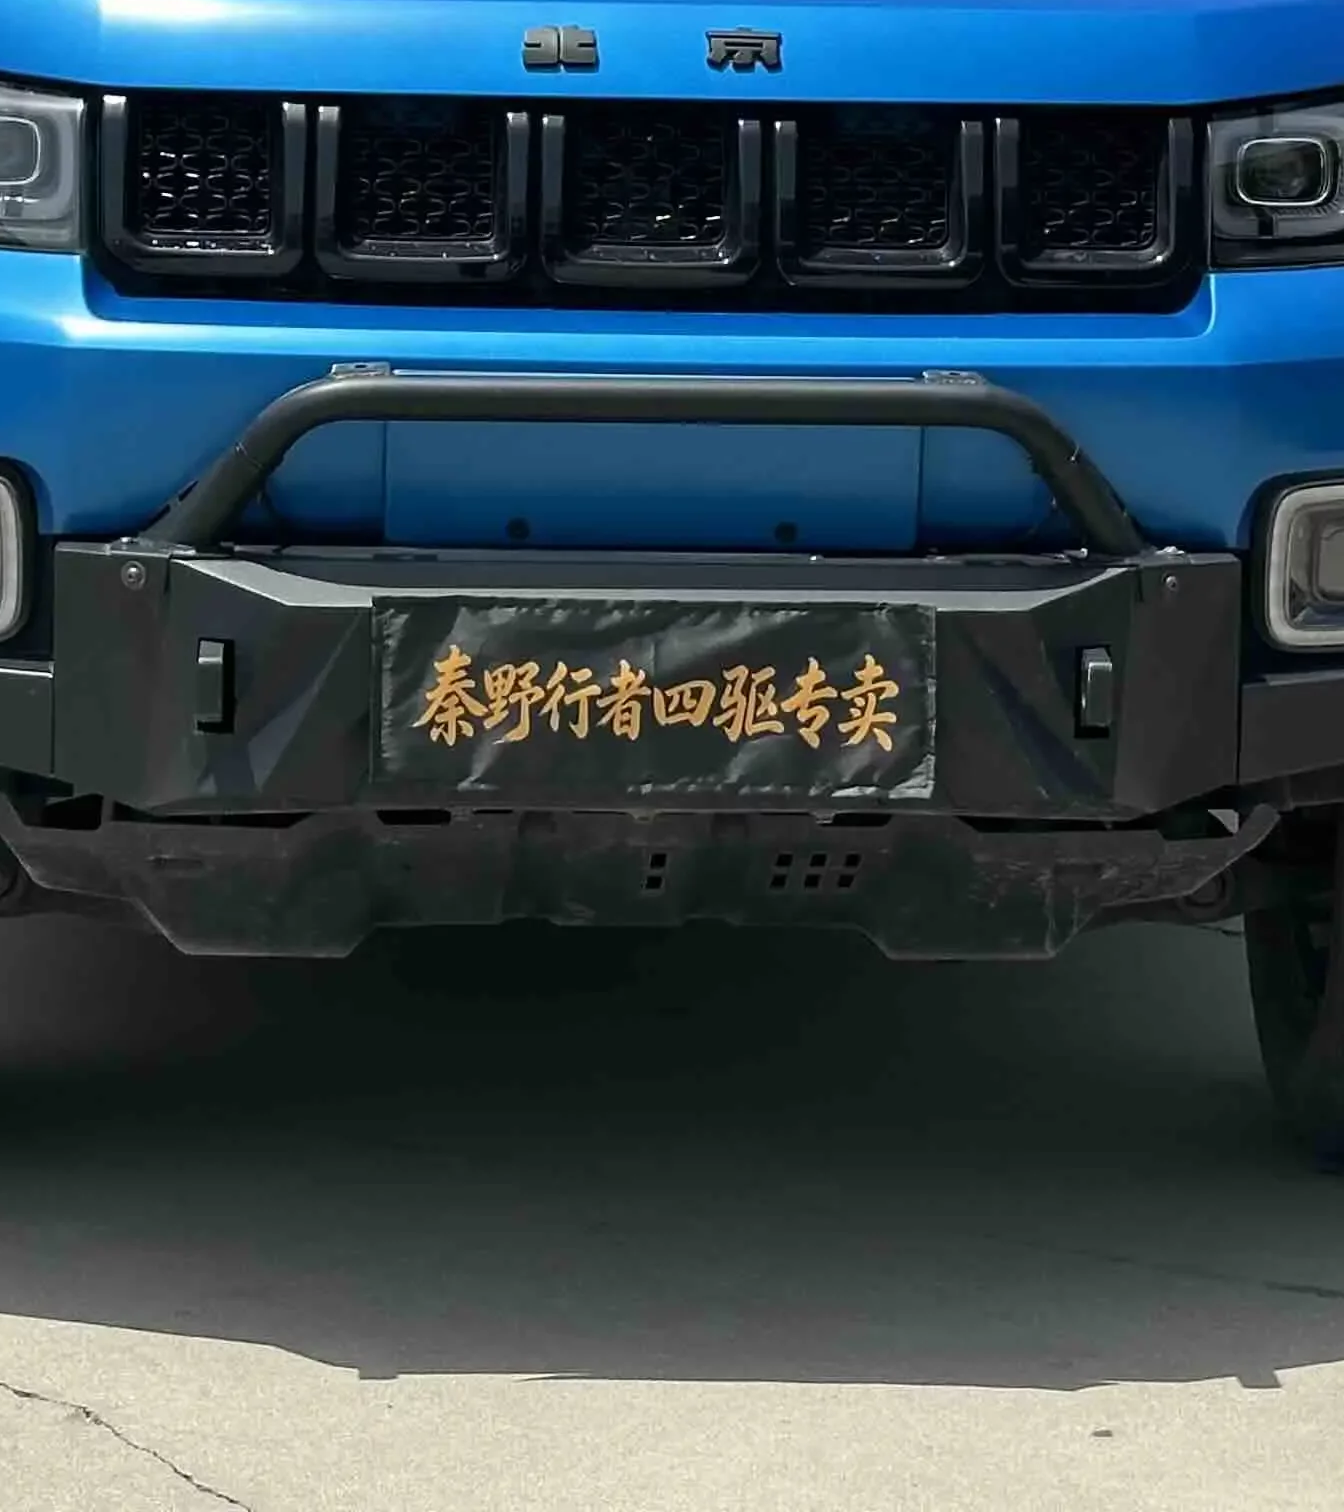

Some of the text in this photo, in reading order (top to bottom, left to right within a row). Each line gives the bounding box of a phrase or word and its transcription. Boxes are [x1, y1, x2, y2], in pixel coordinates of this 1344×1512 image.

[410, 643, 899, 752] 秦野行者四驱专卖
